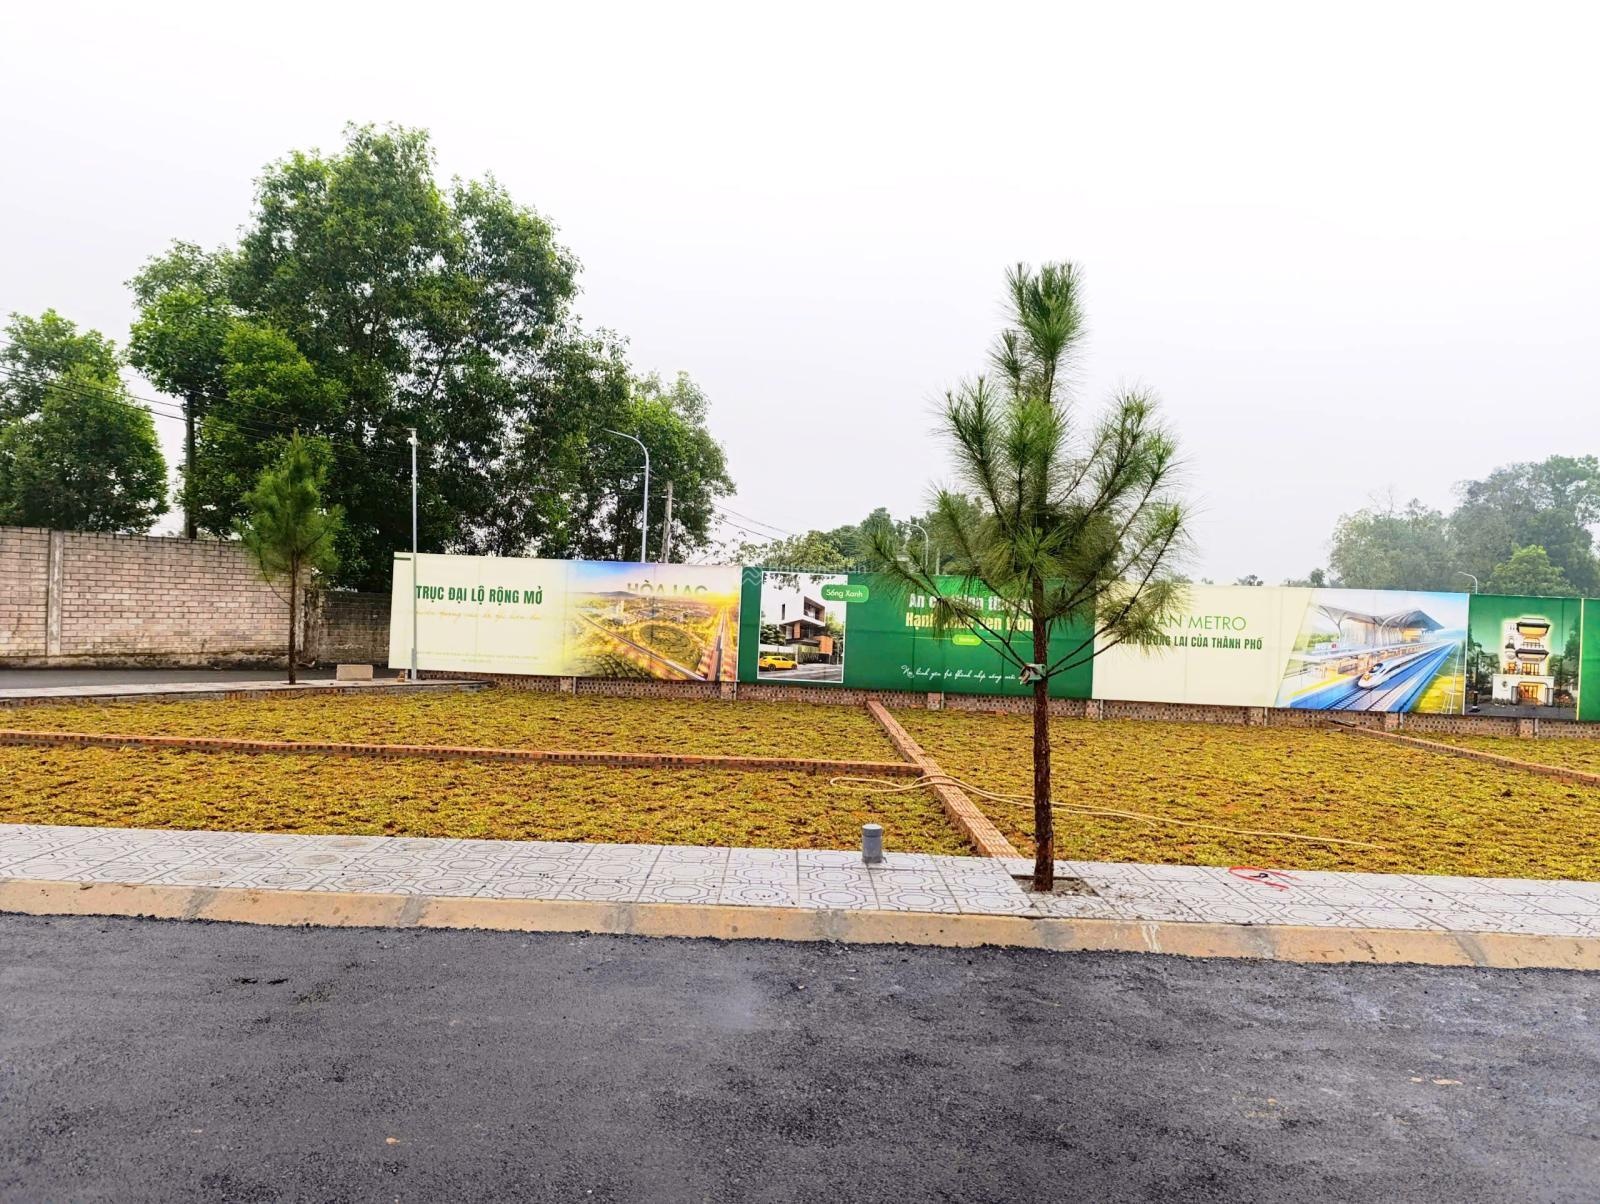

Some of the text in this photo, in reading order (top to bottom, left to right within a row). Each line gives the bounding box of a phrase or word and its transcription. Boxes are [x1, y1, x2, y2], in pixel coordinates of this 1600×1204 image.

[416, 585, 543, 606] TRỤC ĐẠI LỘ RỘNG MỞ
[846, 590, 863, 598] Xanh
[908, 593, 925, 608] An
[1188, 615, 1247, 631] METRO
[1174, 635, 1188, 647] LAI
[1191, 633, 1208, 648] CỦA
[1212, 634, 1241, 649] THÀNH
